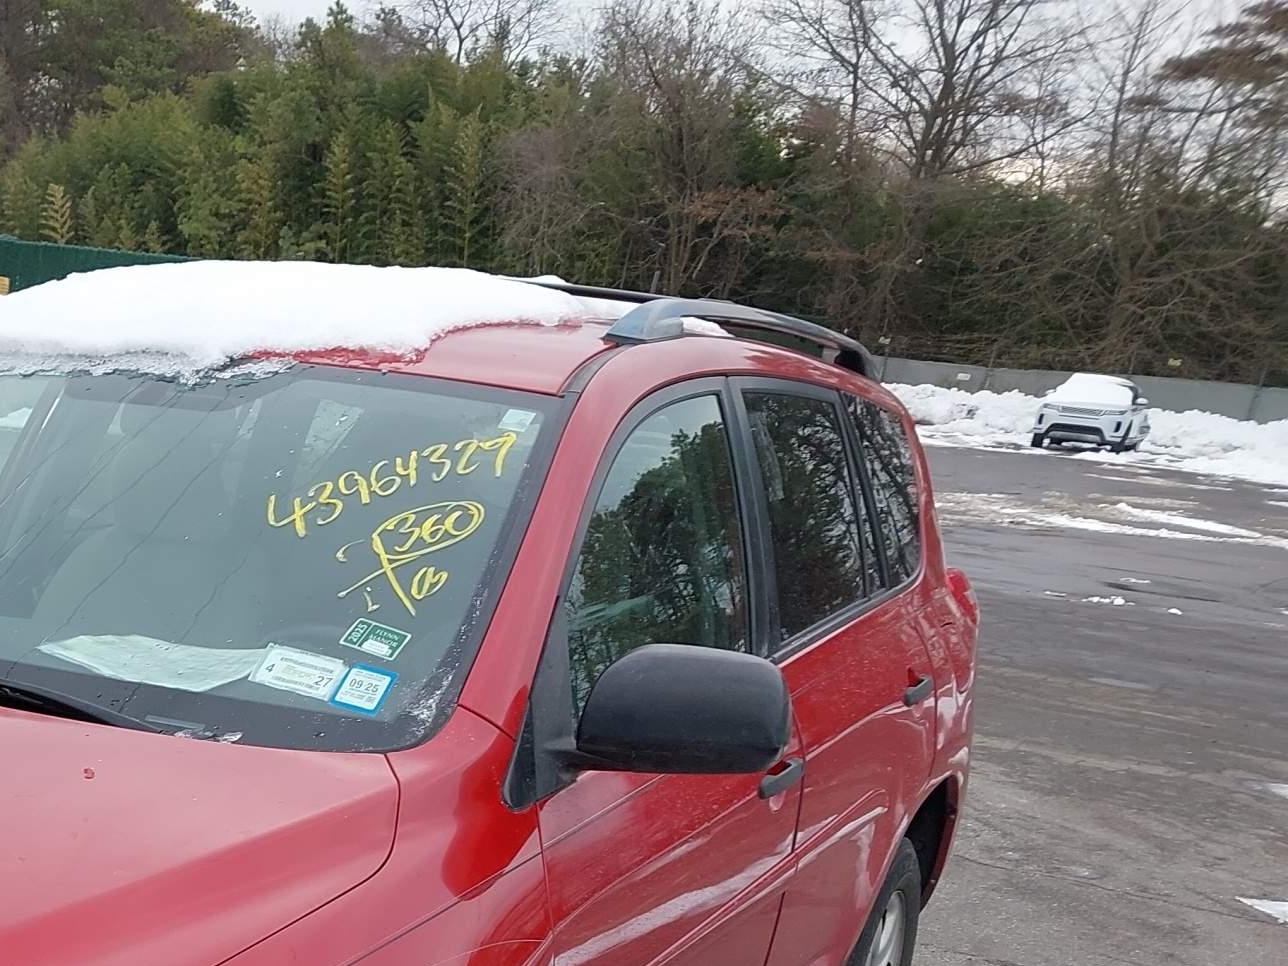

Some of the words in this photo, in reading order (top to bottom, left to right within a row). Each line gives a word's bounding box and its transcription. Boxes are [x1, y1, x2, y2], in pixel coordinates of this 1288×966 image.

[267, 430, 518, 538] 43964327
[386, 503, 478, 552] 360
[347, 623, 368, 643] 2025
[265, 663, 276, 673] 4
[314, 675, 334, 689] 27
[349, 678, 364, 689] 09
[365, 681, 380, 693] 25
